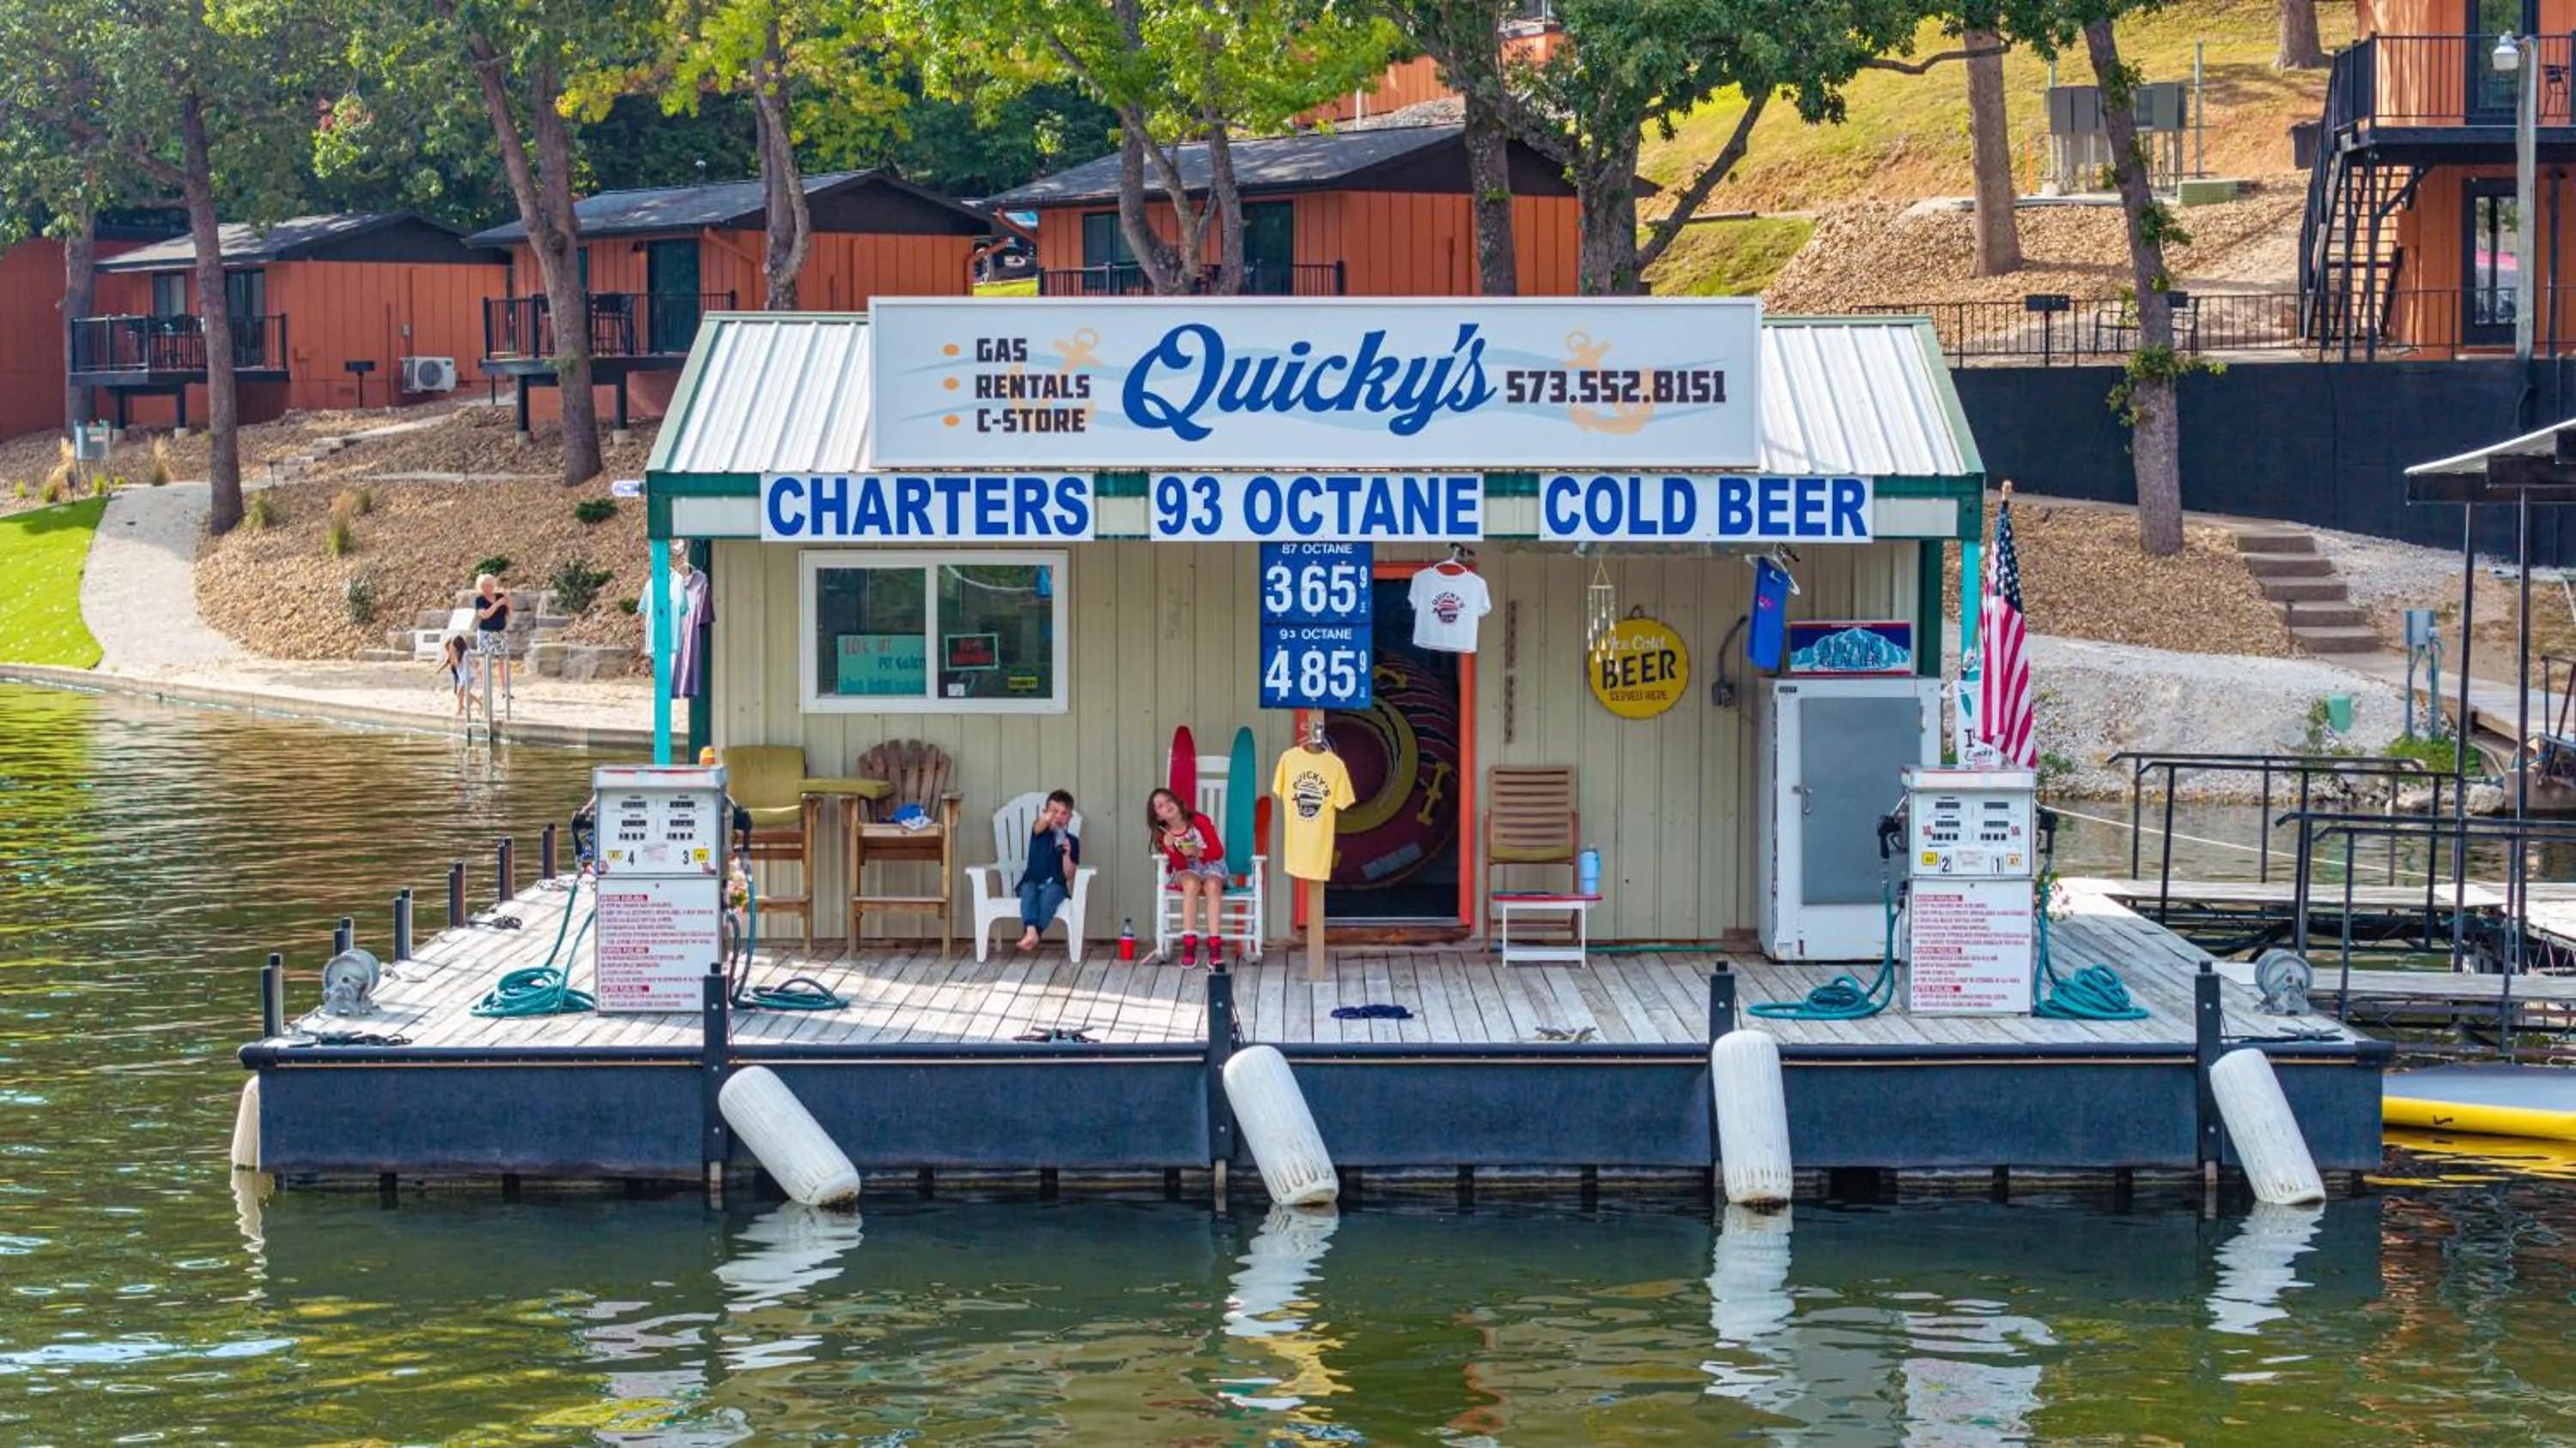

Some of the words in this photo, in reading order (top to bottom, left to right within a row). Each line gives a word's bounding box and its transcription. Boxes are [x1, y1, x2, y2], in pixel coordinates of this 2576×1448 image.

[976, 338, 1028, 362] GAS
[975, 374, 1091, 399] RENTALS
[1122, 323, 1498, 441] Quicky's
[1507, 370, 1727, 403] 573.552.8151
[976, 409, 1086, 432] C-STORE
[768, 477, 1090, 537] CHARTERS
[1156, 475, 1223, 537] 93
[1242, 476, 1479, 537] OCTANE
[1545, 475, 1698, 536] COLD
[1718, 478, 1868, 537] BEER
[1281, 544, 1297, 554] 87
[1302, 544, 1353, 554] OCTANE
[1279, 629, 1296, 640] 93
[1301, 628, 1352, 640] OCTANE
[1601, 649, 1677, 691] BEER
[628, 850, 635, 866] 4
[683, 850, 690, 866] 3
[1941, 858, 1949, 873] 2
